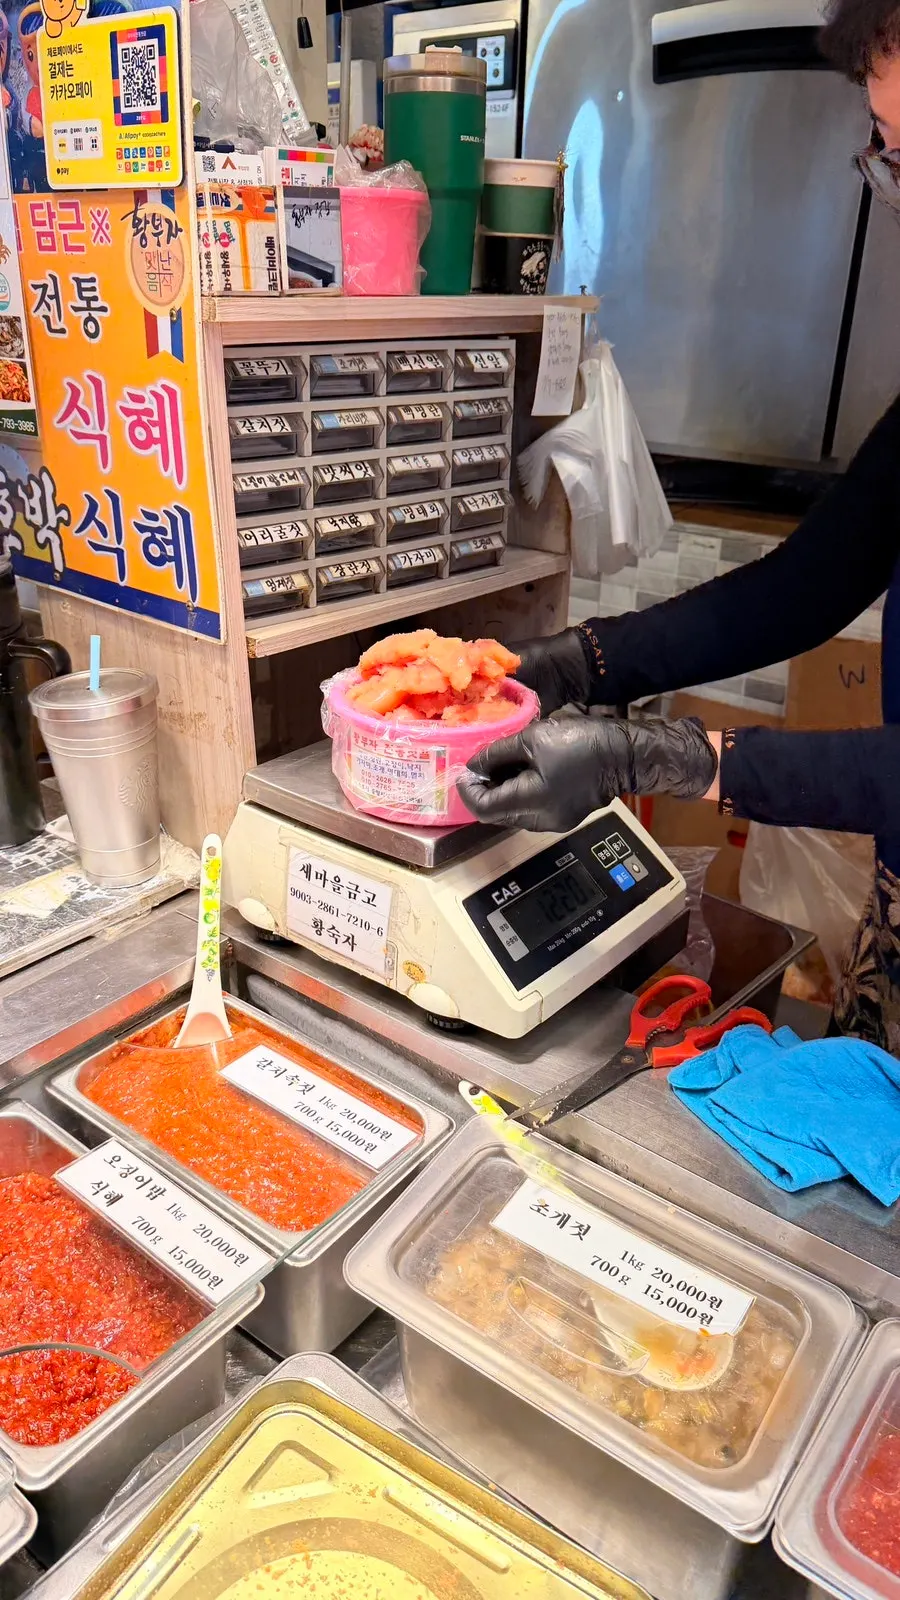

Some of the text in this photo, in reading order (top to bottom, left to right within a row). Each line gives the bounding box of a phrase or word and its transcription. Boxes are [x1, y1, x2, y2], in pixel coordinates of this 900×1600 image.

[48, 61, 74, 79] 결제는
[50, 80, 93, 101] 카카오페이
[121, 202, 184, 249] 황부자
[31, 273, 108, 339] 전통
[239, 359, 289, 376] 꼴뚜기
[56, 374, 184, 486] 식혜
[239, 415, 290, 433] 갈치젓
[75, 489, 198, 603] 식혜
[244, 521, 304, 546] 어리굴젓
[400, 548, 437, 566] 가자미
[299, 862, 377, 908] 새마을금고
[491, 881, 522, 906] CAS
[290, 886, 384, 937] 9003-2861-7210-6
[311, 916, 357, 952] 황숙자
[256, 1057, 393, 1142] 갈치속젓 1kg 20,000원
[293, 1101, 378, 1155] 700g 15,000원
[103, 1154, 250, 1268] 오징어밥 1kg 20,000원
[131, 1215, 164, 1246] 700g
[167, 1244, 224, 1291] 15,000원
[589, 1254, 715, 1328] 700g 15,000원
[618, 1250, 646, 1272] 1kg
[651, 1266, 724, 1313] 20,000원
